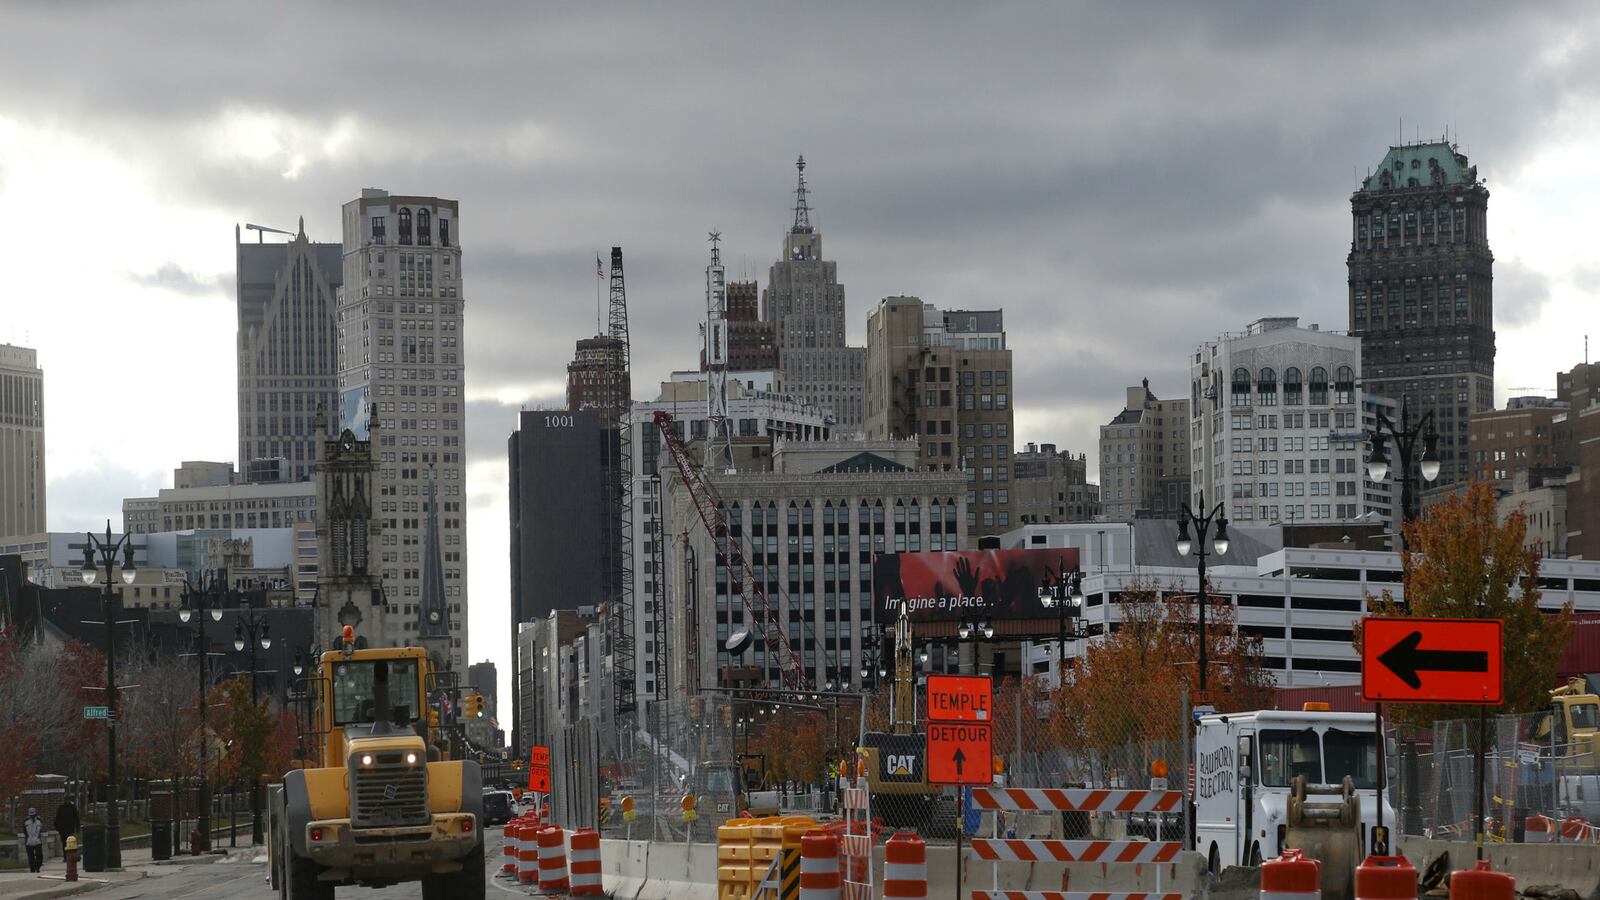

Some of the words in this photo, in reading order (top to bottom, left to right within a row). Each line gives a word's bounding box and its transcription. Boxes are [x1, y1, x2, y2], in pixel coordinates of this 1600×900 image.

[545, 415, 574, 428] 1001
[885, 595, 936, 613] Imgine
[938, 597, 947, 608] a
[932, 692, 988, 711] TEMPLE
[86, 708, 107, 717] Alfred
[931, 726, 987, 742] DETOUR
[887, 754, 916, 775] CAT
[1200, 770, 1233, 799] ELECTRIC
[717, 803, 729, 813] CAT
